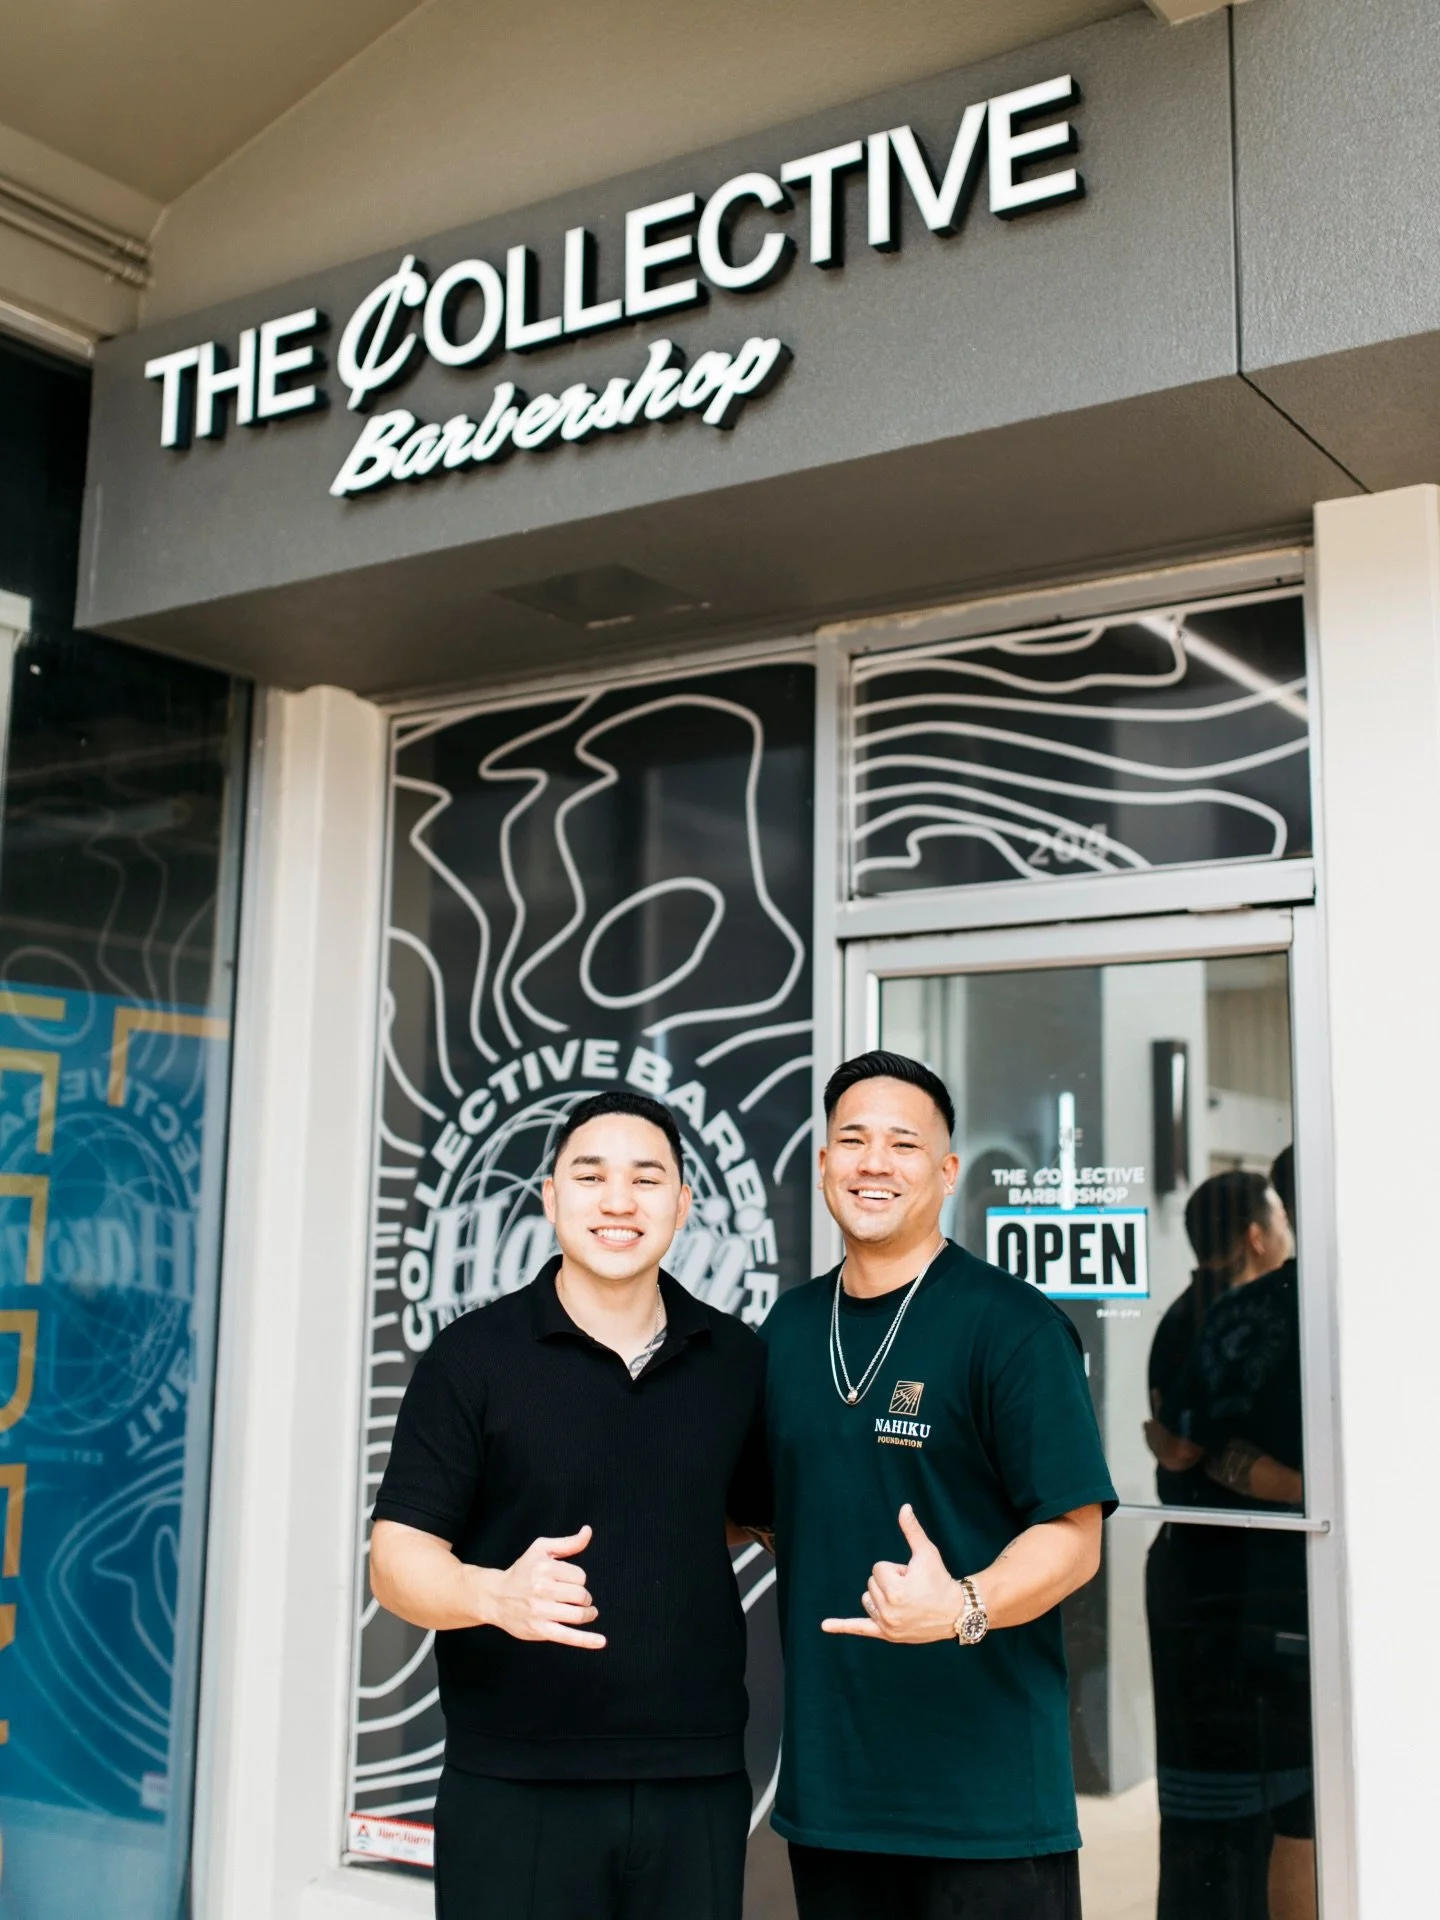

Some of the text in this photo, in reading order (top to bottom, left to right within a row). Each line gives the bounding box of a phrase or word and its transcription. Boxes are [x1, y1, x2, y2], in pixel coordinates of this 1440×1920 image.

[144, 306, 326, 449] THE
[328, 336, 790, 500] Barbershop
[400, 1038, 622, 1353] COLLECTIVE
[991, 1168, 1028, 1186] THE
[997, 1222, 1137, 1286] OPEN
[874, 1418, 931, 1438] NAHIKU
[877, 1435, 923, 1448] FOUNDATION
